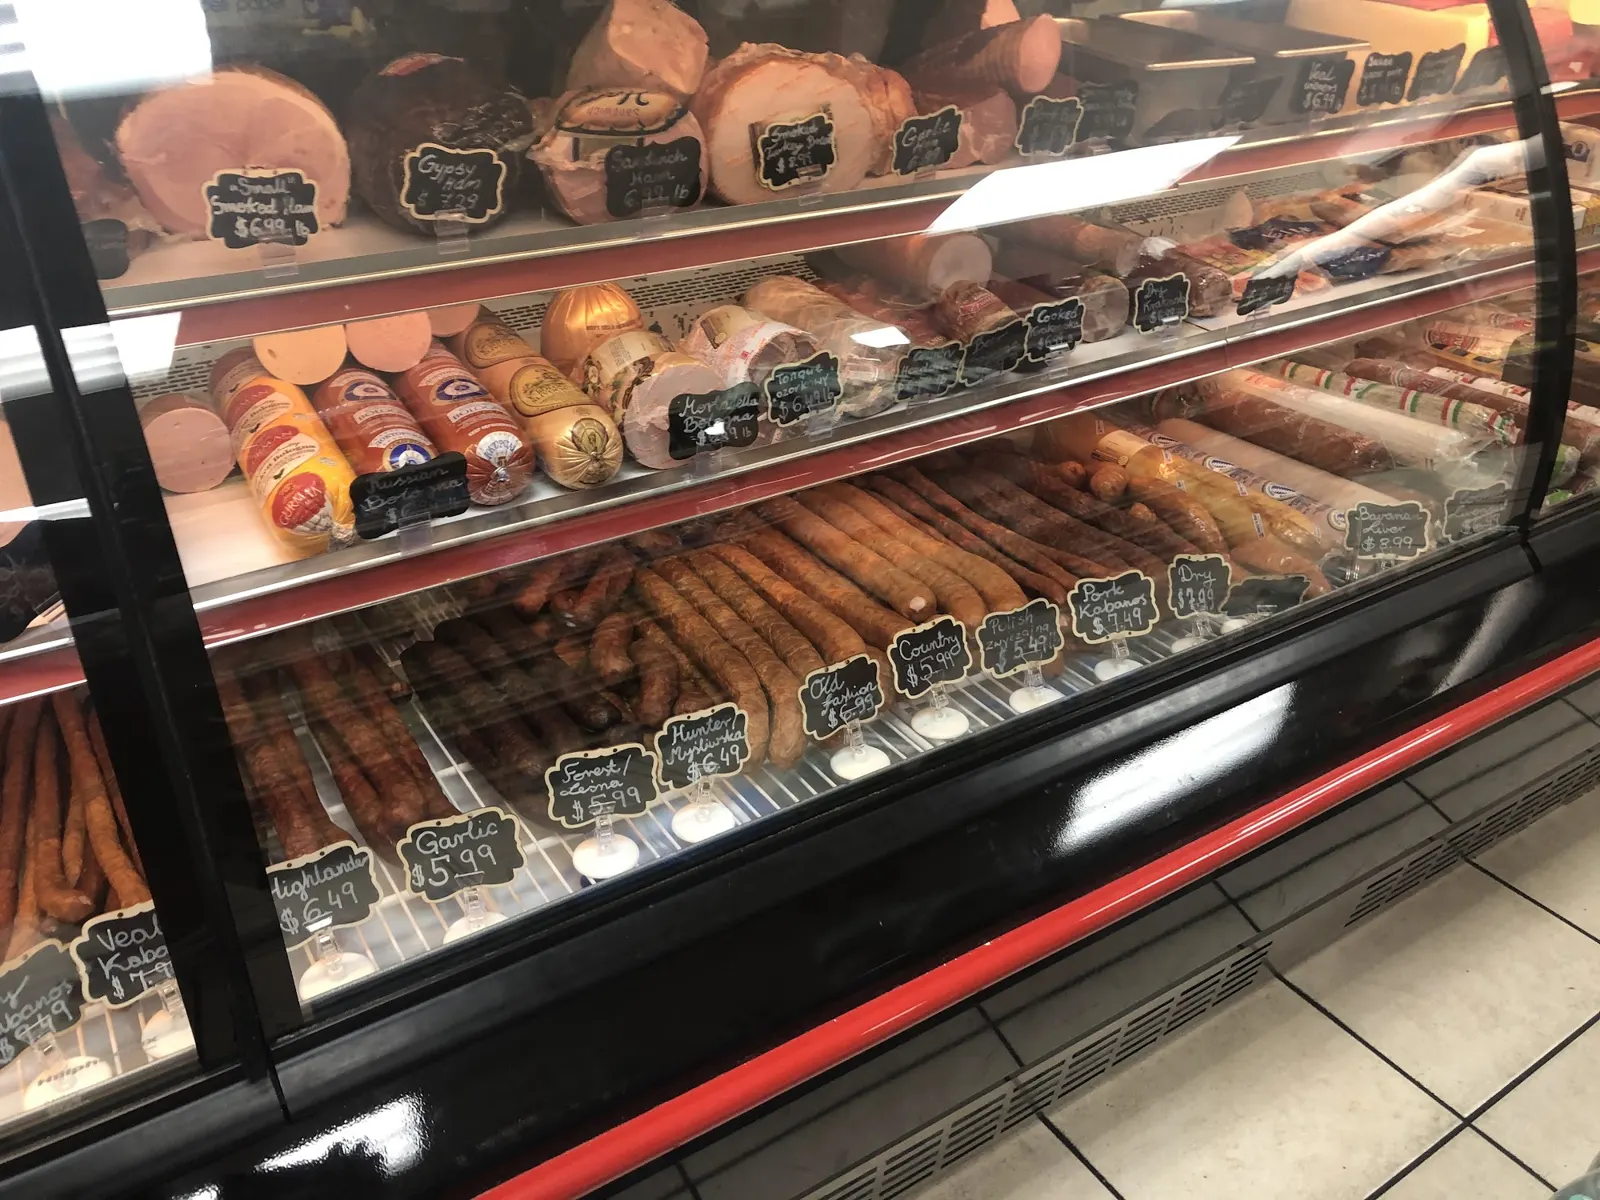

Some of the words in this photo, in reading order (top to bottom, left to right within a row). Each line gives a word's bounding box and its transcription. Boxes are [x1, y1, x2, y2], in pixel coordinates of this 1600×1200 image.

[417, 153, 477, 184] Gypsy
[210, 194, 279, 215] Smoked
[365, 467, 449, 494] Russian
[1362, 520, 1406, 534] Liver
[1178, 564, 1217, 589] Dry
[1082, 581, 1125, 603] Pork
[1079, 593, 1147, 619] Kabanos
[989, 608, 1033, 634] Polish
[899, 630, 961, 661] Country
[810, 672, 845, 699] Old
[416, 820, 499, 855] Garlic
[96, 912, 164, 951] Veal
